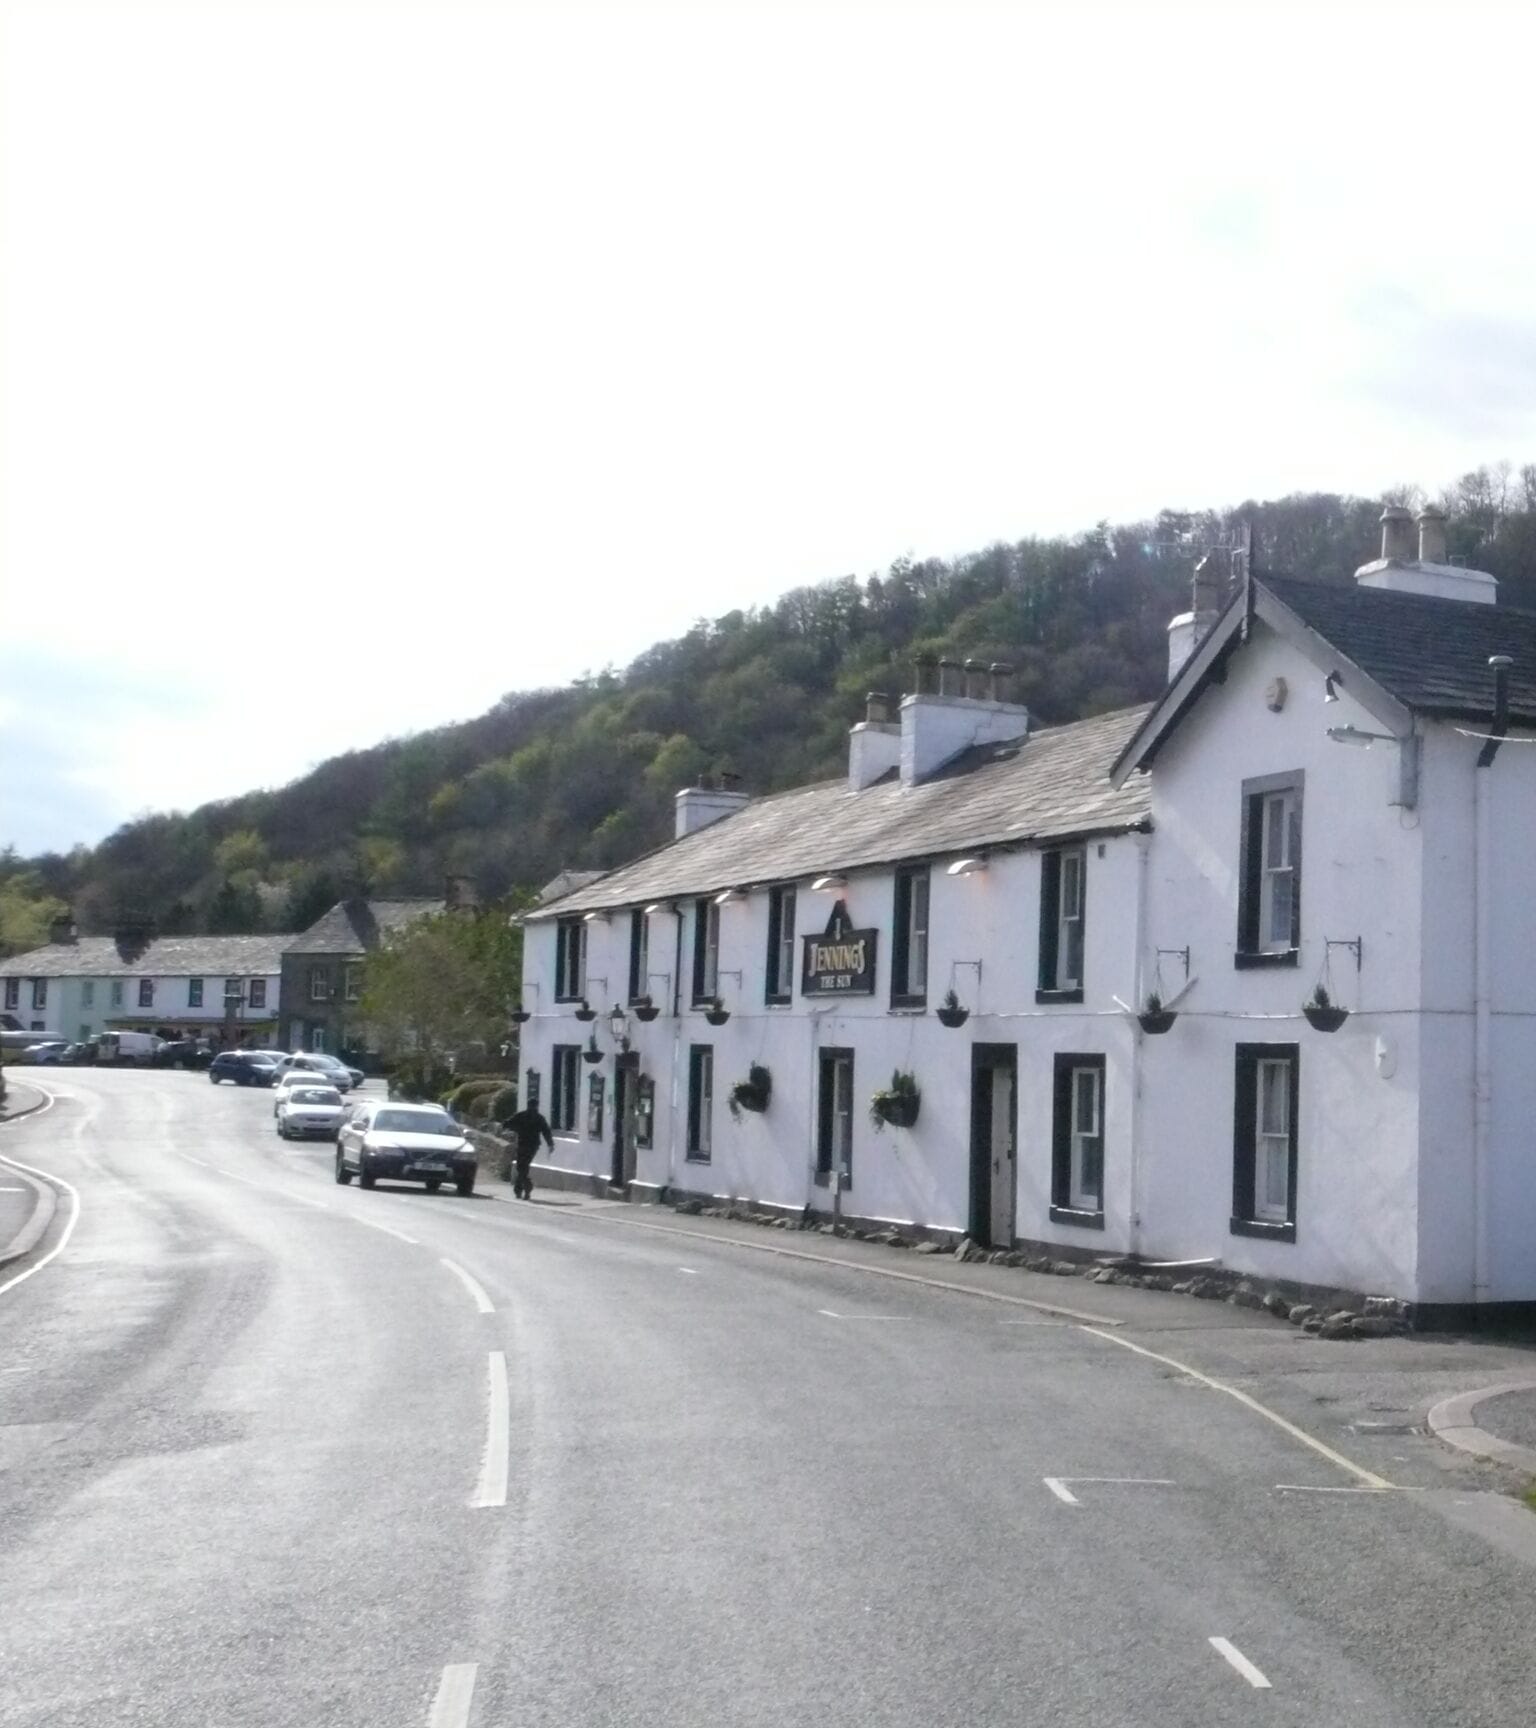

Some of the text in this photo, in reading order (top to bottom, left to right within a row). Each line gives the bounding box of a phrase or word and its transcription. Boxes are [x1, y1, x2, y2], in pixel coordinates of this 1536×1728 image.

[808, 939, 866, 977] JENNINGS
[820, 975, 853, 989] THE SUN
